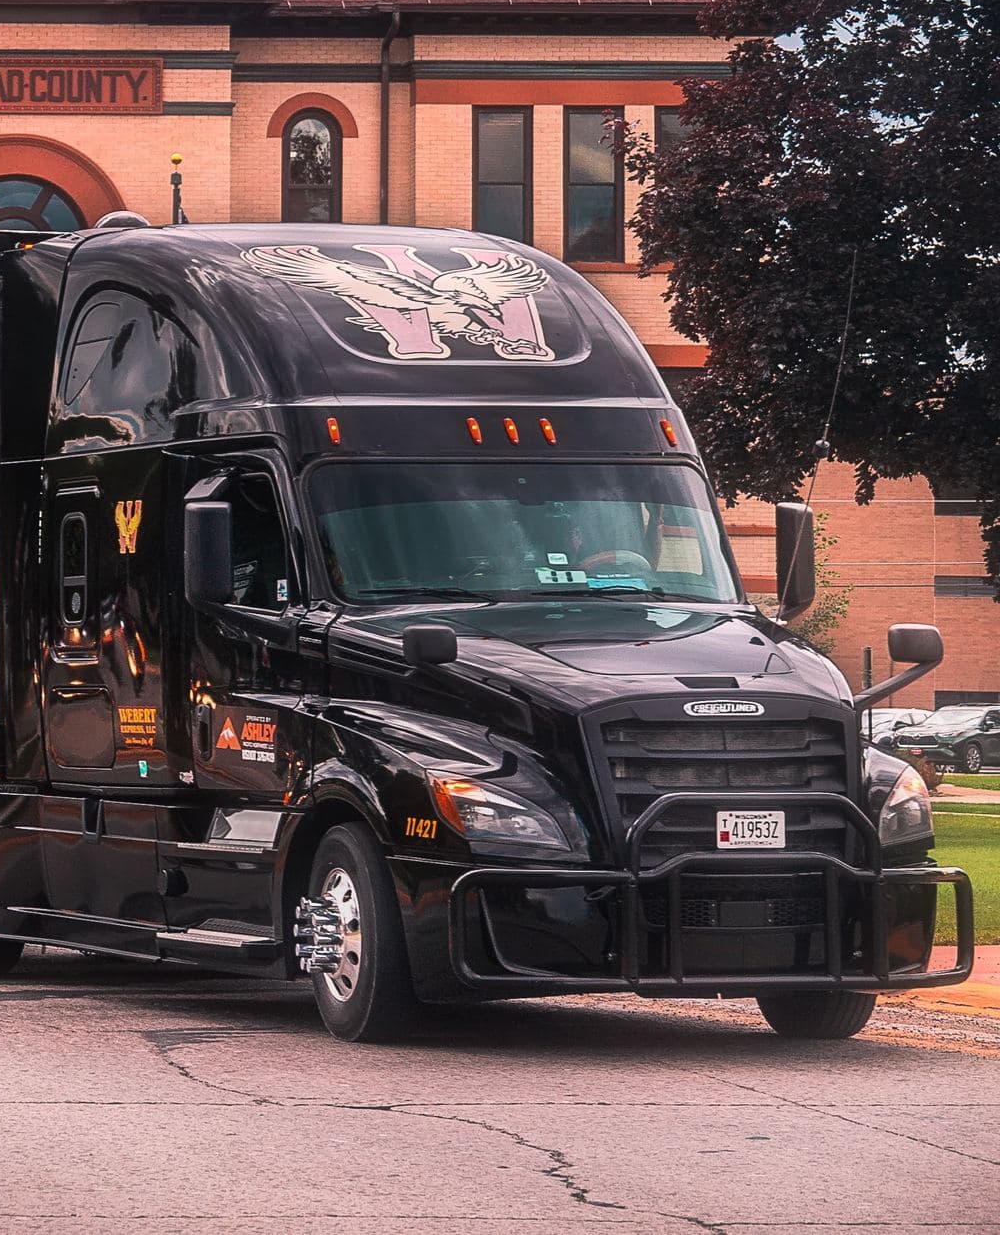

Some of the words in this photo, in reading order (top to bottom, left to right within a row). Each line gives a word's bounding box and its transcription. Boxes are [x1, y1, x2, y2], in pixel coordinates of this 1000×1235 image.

[118, 708, 157, 723] WEBERT
[692, 702, 757, 714] FREIGHTLINER
[240, 722, 276, 742] ASHLEY
[405, 816, 438, 839] 11421
[721, 818, 728, 828] T
[731, 820, 779, 839] 41953Z
